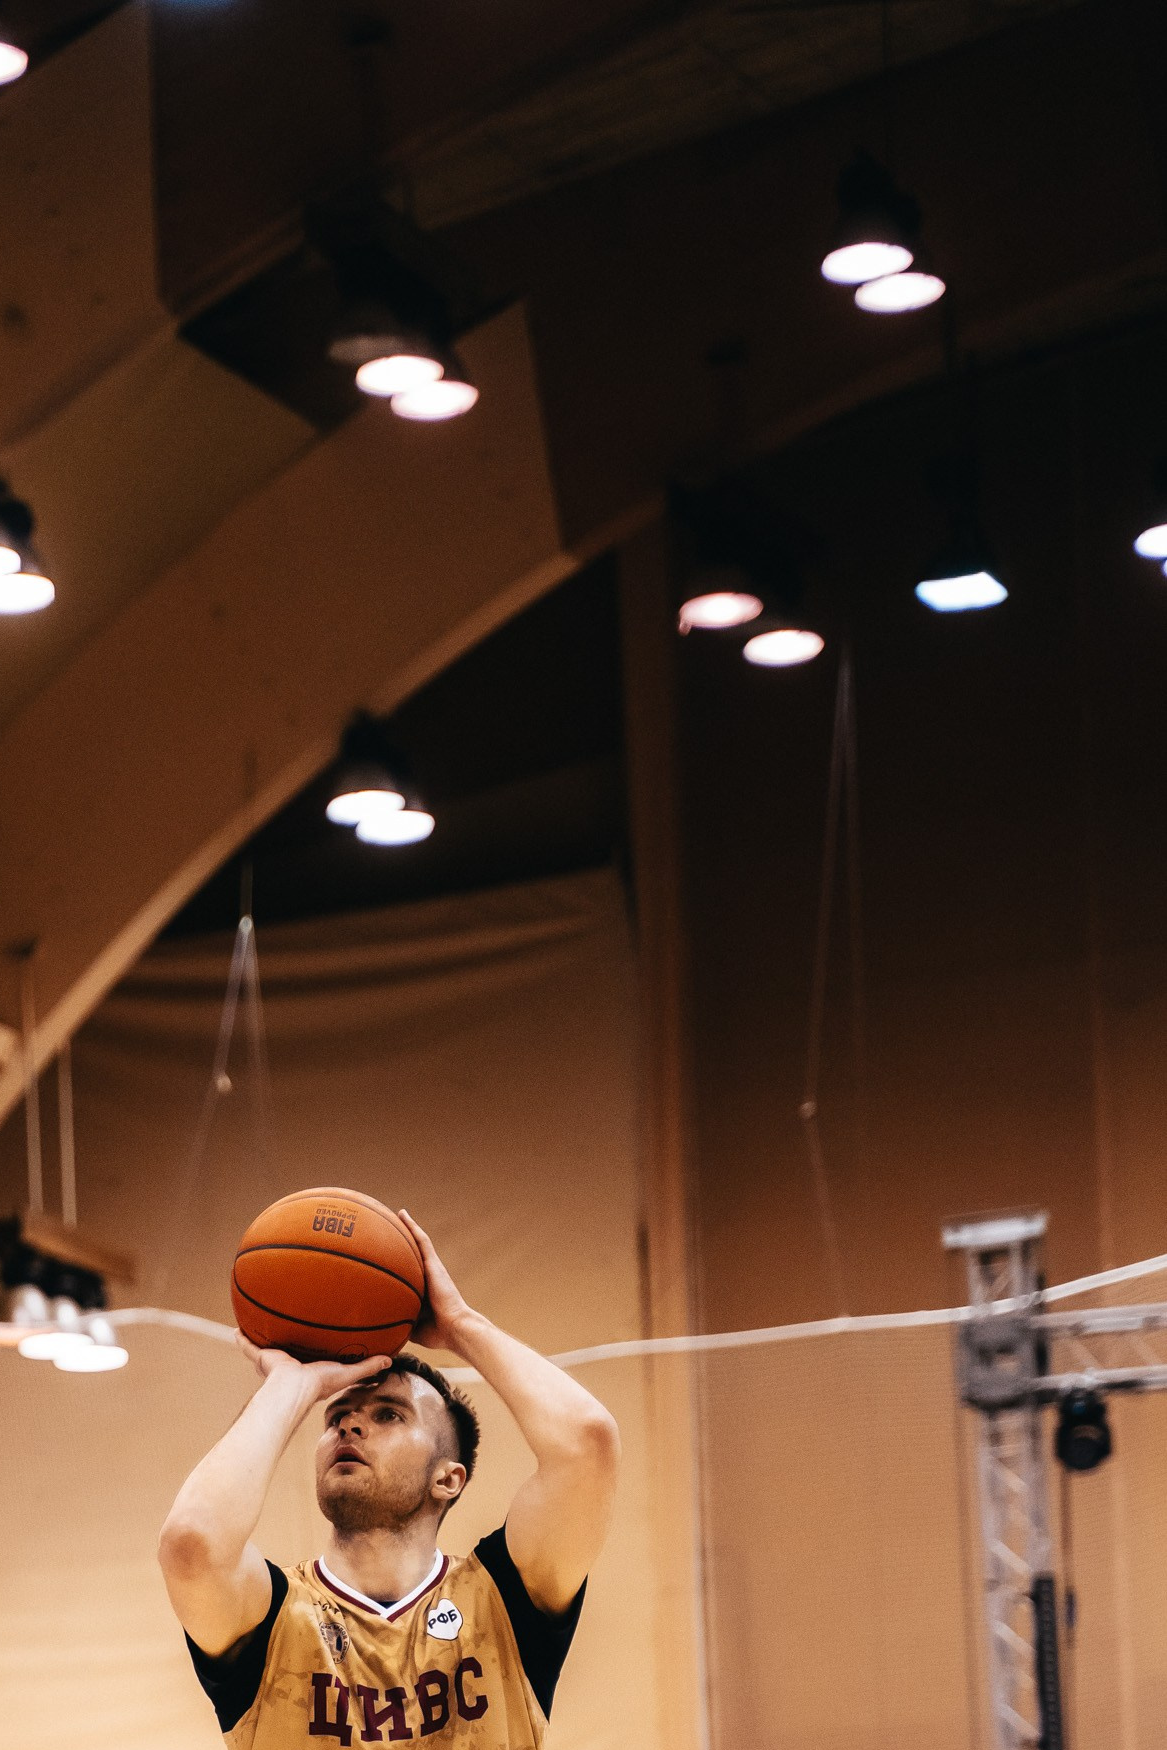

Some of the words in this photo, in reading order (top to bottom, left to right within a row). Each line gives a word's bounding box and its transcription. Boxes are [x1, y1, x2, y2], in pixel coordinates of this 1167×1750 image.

[312, 1215, 355, 1237] FIBA
[428, 1609, 458, 1629] РФБ
[309, 1656, 489, 1747] ЦИВС
